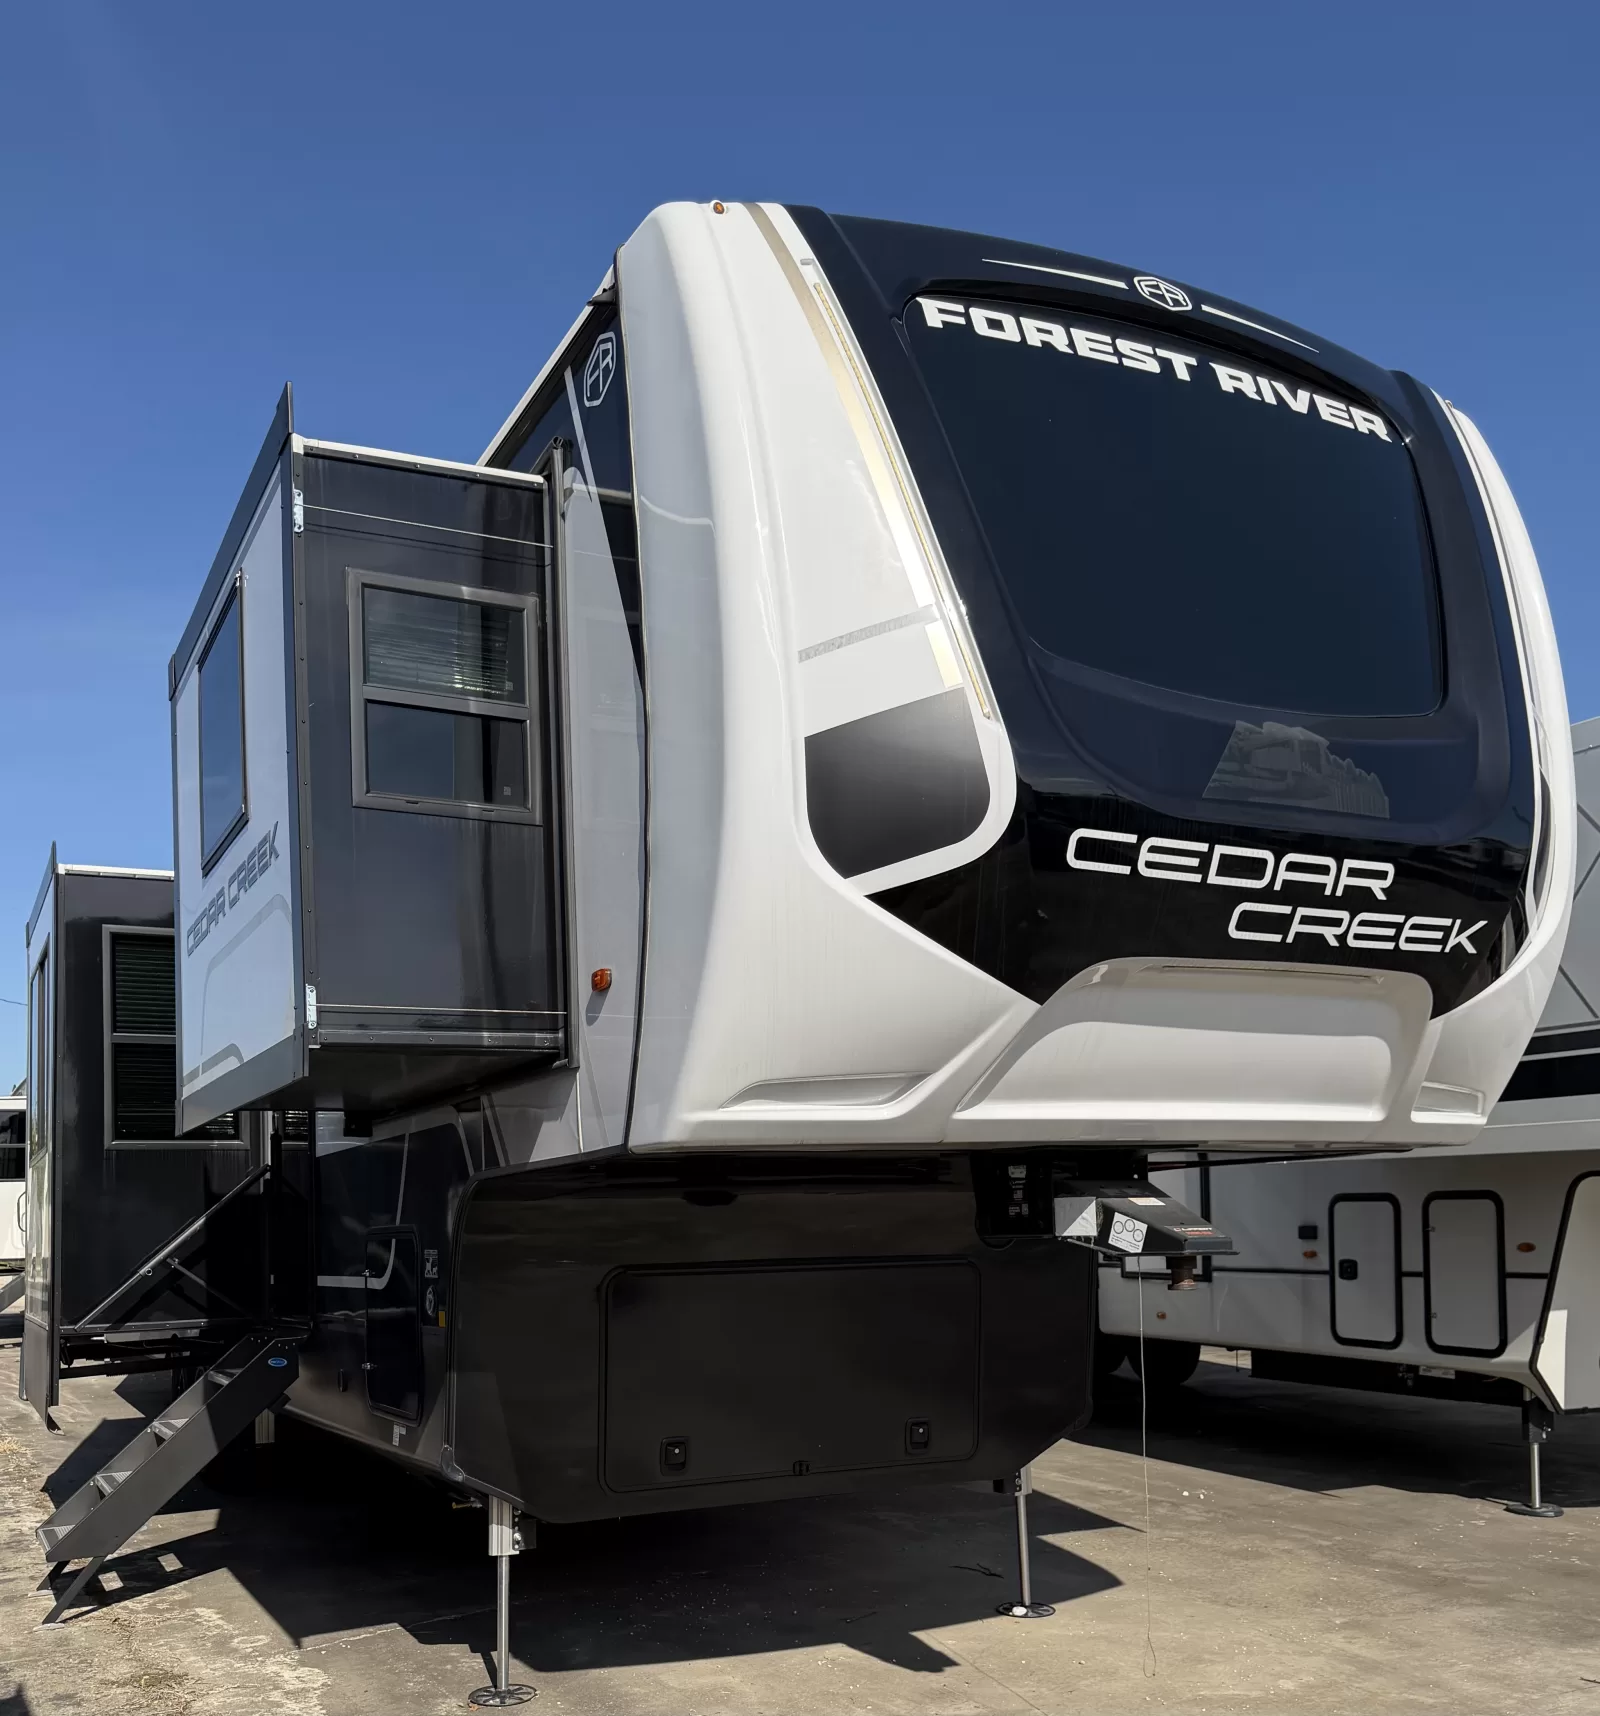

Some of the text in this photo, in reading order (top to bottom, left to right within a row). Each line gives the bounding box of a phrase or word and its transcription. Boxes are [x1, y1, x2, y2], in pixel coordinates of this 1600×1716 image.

[916, 297, 1392, 443] FOREST RIVER
[187, 820, 280, 957] CEDAR CREEK
[1066, 828, 1395, 900] CEDAR
[1228, 902, 1488, 954] CREEK
